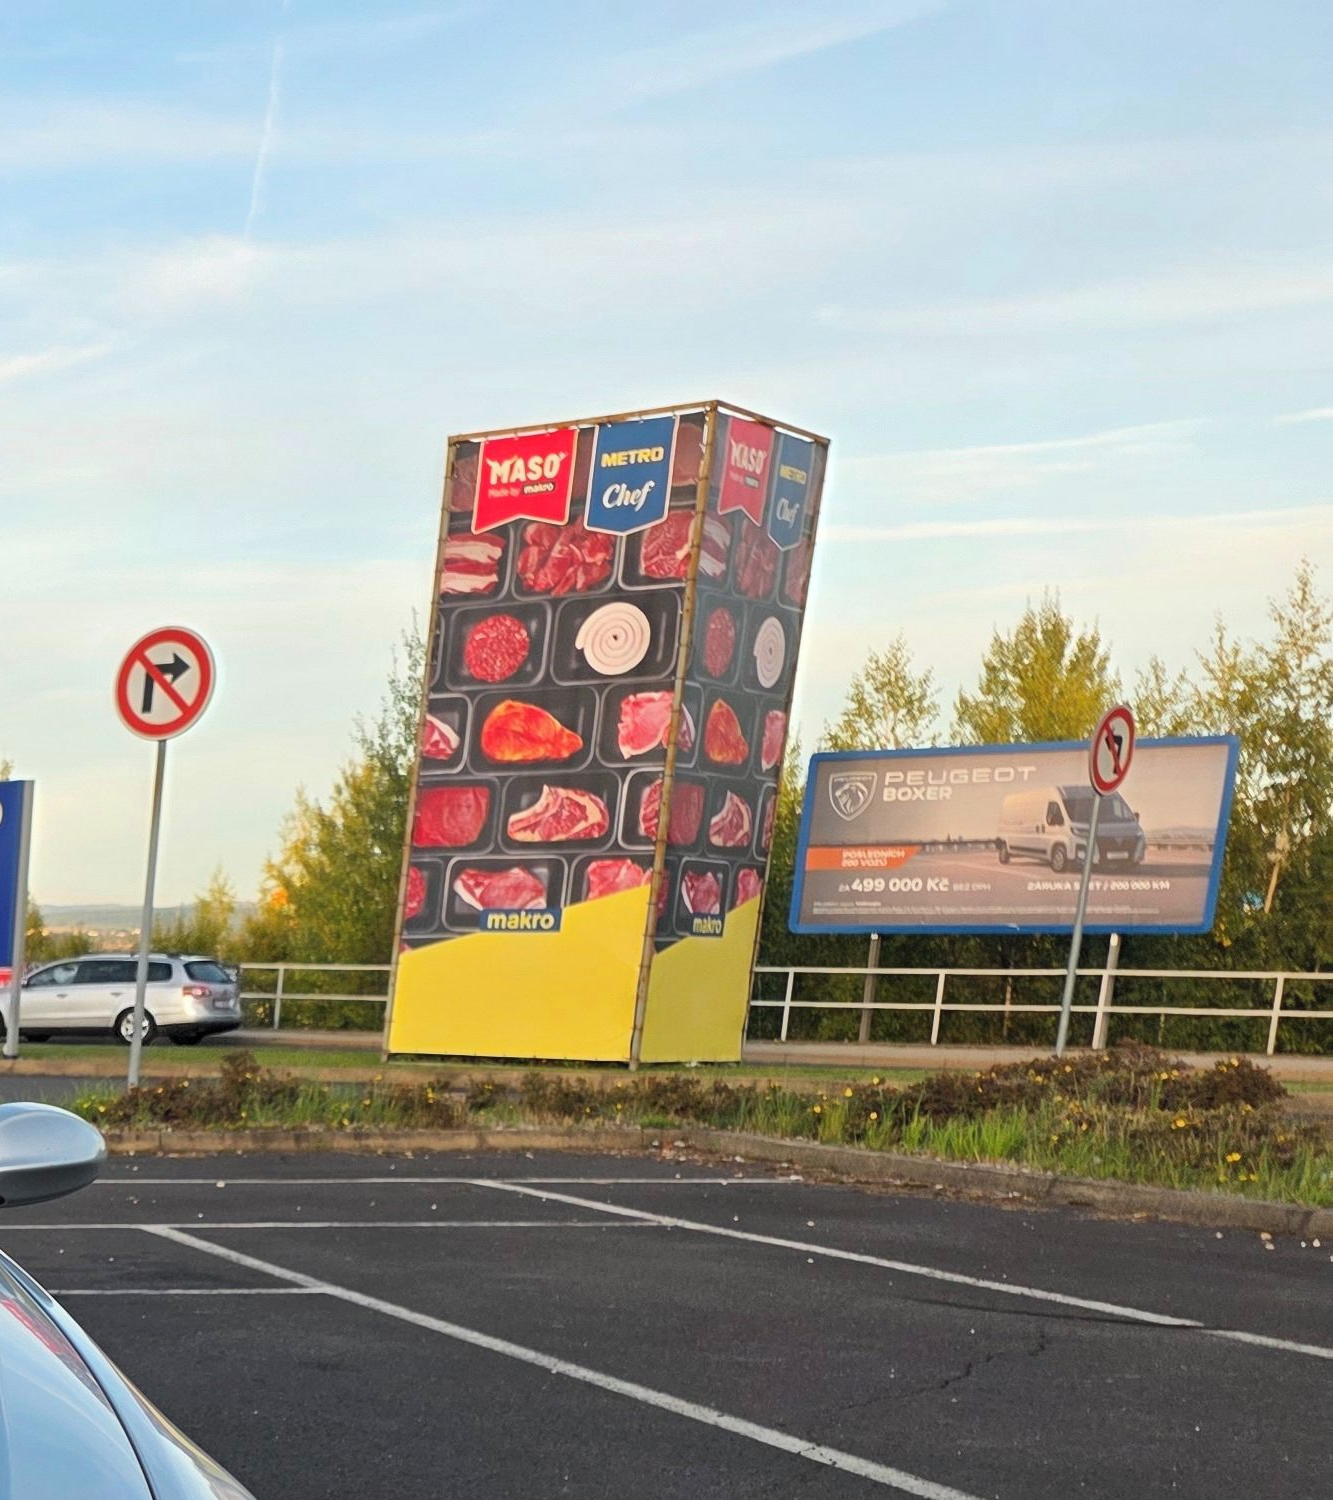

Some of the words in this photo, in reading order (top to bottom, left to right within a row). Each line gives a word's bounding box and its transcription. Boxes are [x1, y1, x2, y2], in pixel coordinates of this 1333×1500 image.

[601, 447, 664, 467] METRO
[487, 452, 566, 485] MASO
[523, 482, 554, 494] makro
[602, 480, 655, 511] Chef
[884, 766, 1037, 785] PEUGEOT
[883, 786, 953, 801] BOXER
[852, 877, 885, 892] 499
[888, 878, 923, 892] 000
[926, 877, 950, 892] Kč
[487, 910, 555, 931] makro
[693, 916, 723, 935] makro
